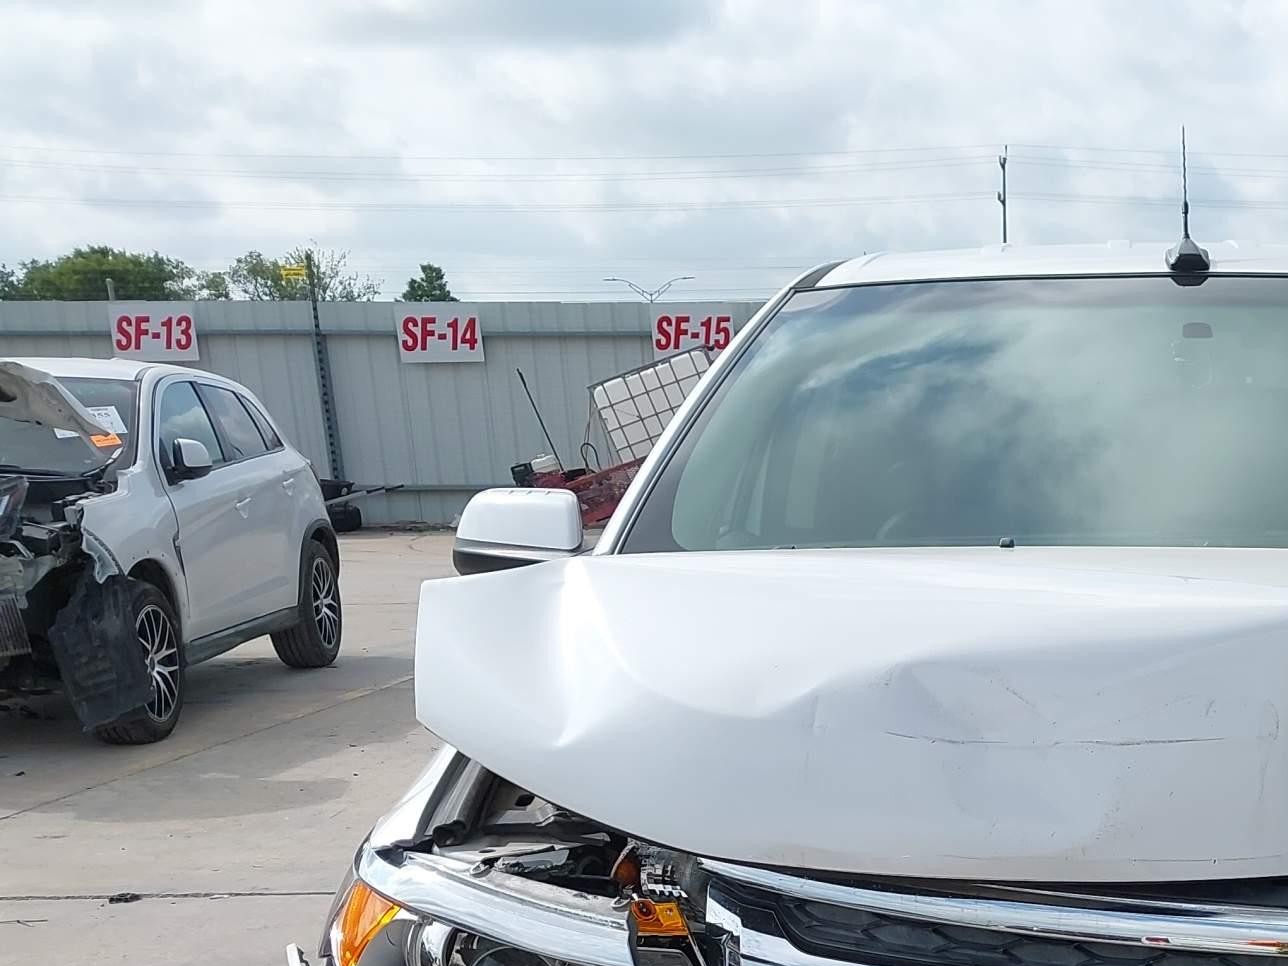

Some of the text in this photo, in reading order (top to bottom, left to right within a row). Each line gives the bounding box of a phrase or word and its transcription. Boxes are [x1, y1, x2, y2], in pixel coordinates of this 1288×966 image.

[115, 315, 193, 351] SF-13
[402, 316, 478, 352] SF-14
[655, 315, 731, 350] SF-15
